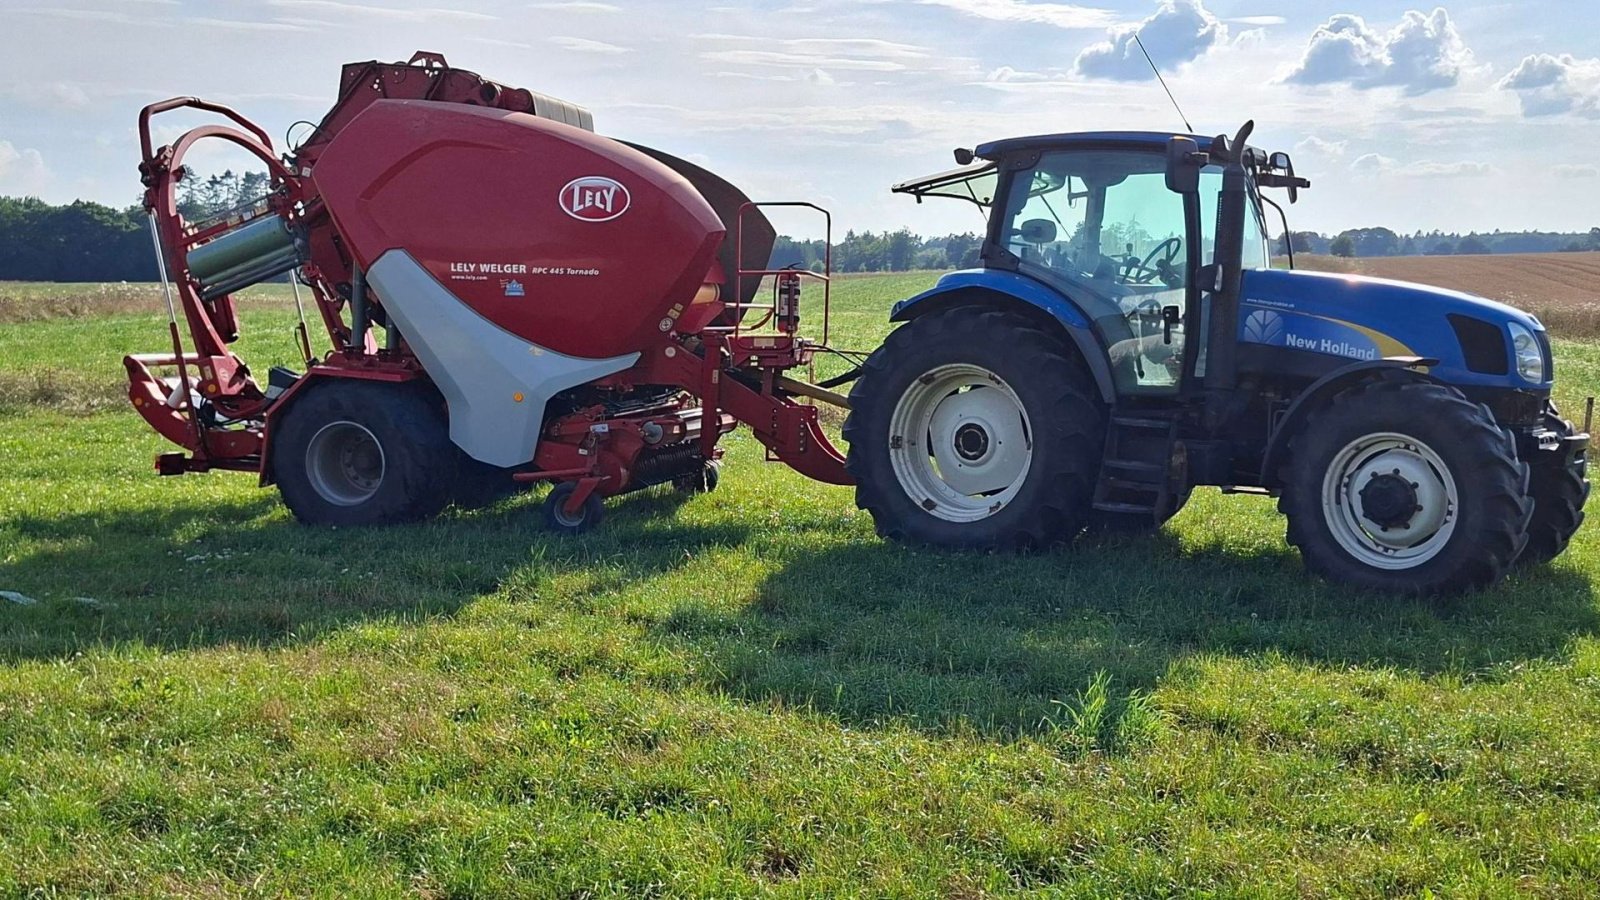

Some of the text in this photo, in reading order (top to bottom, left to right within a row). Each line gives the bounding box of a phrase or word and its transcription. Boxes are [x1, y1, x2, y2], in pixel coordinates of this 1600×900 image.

[572, 184, 615, 213] LELY
[450, 262, 600, 276] LELY WELGER RPC 445 Tornado
[1286, 333, 1375, 361] New Holland
